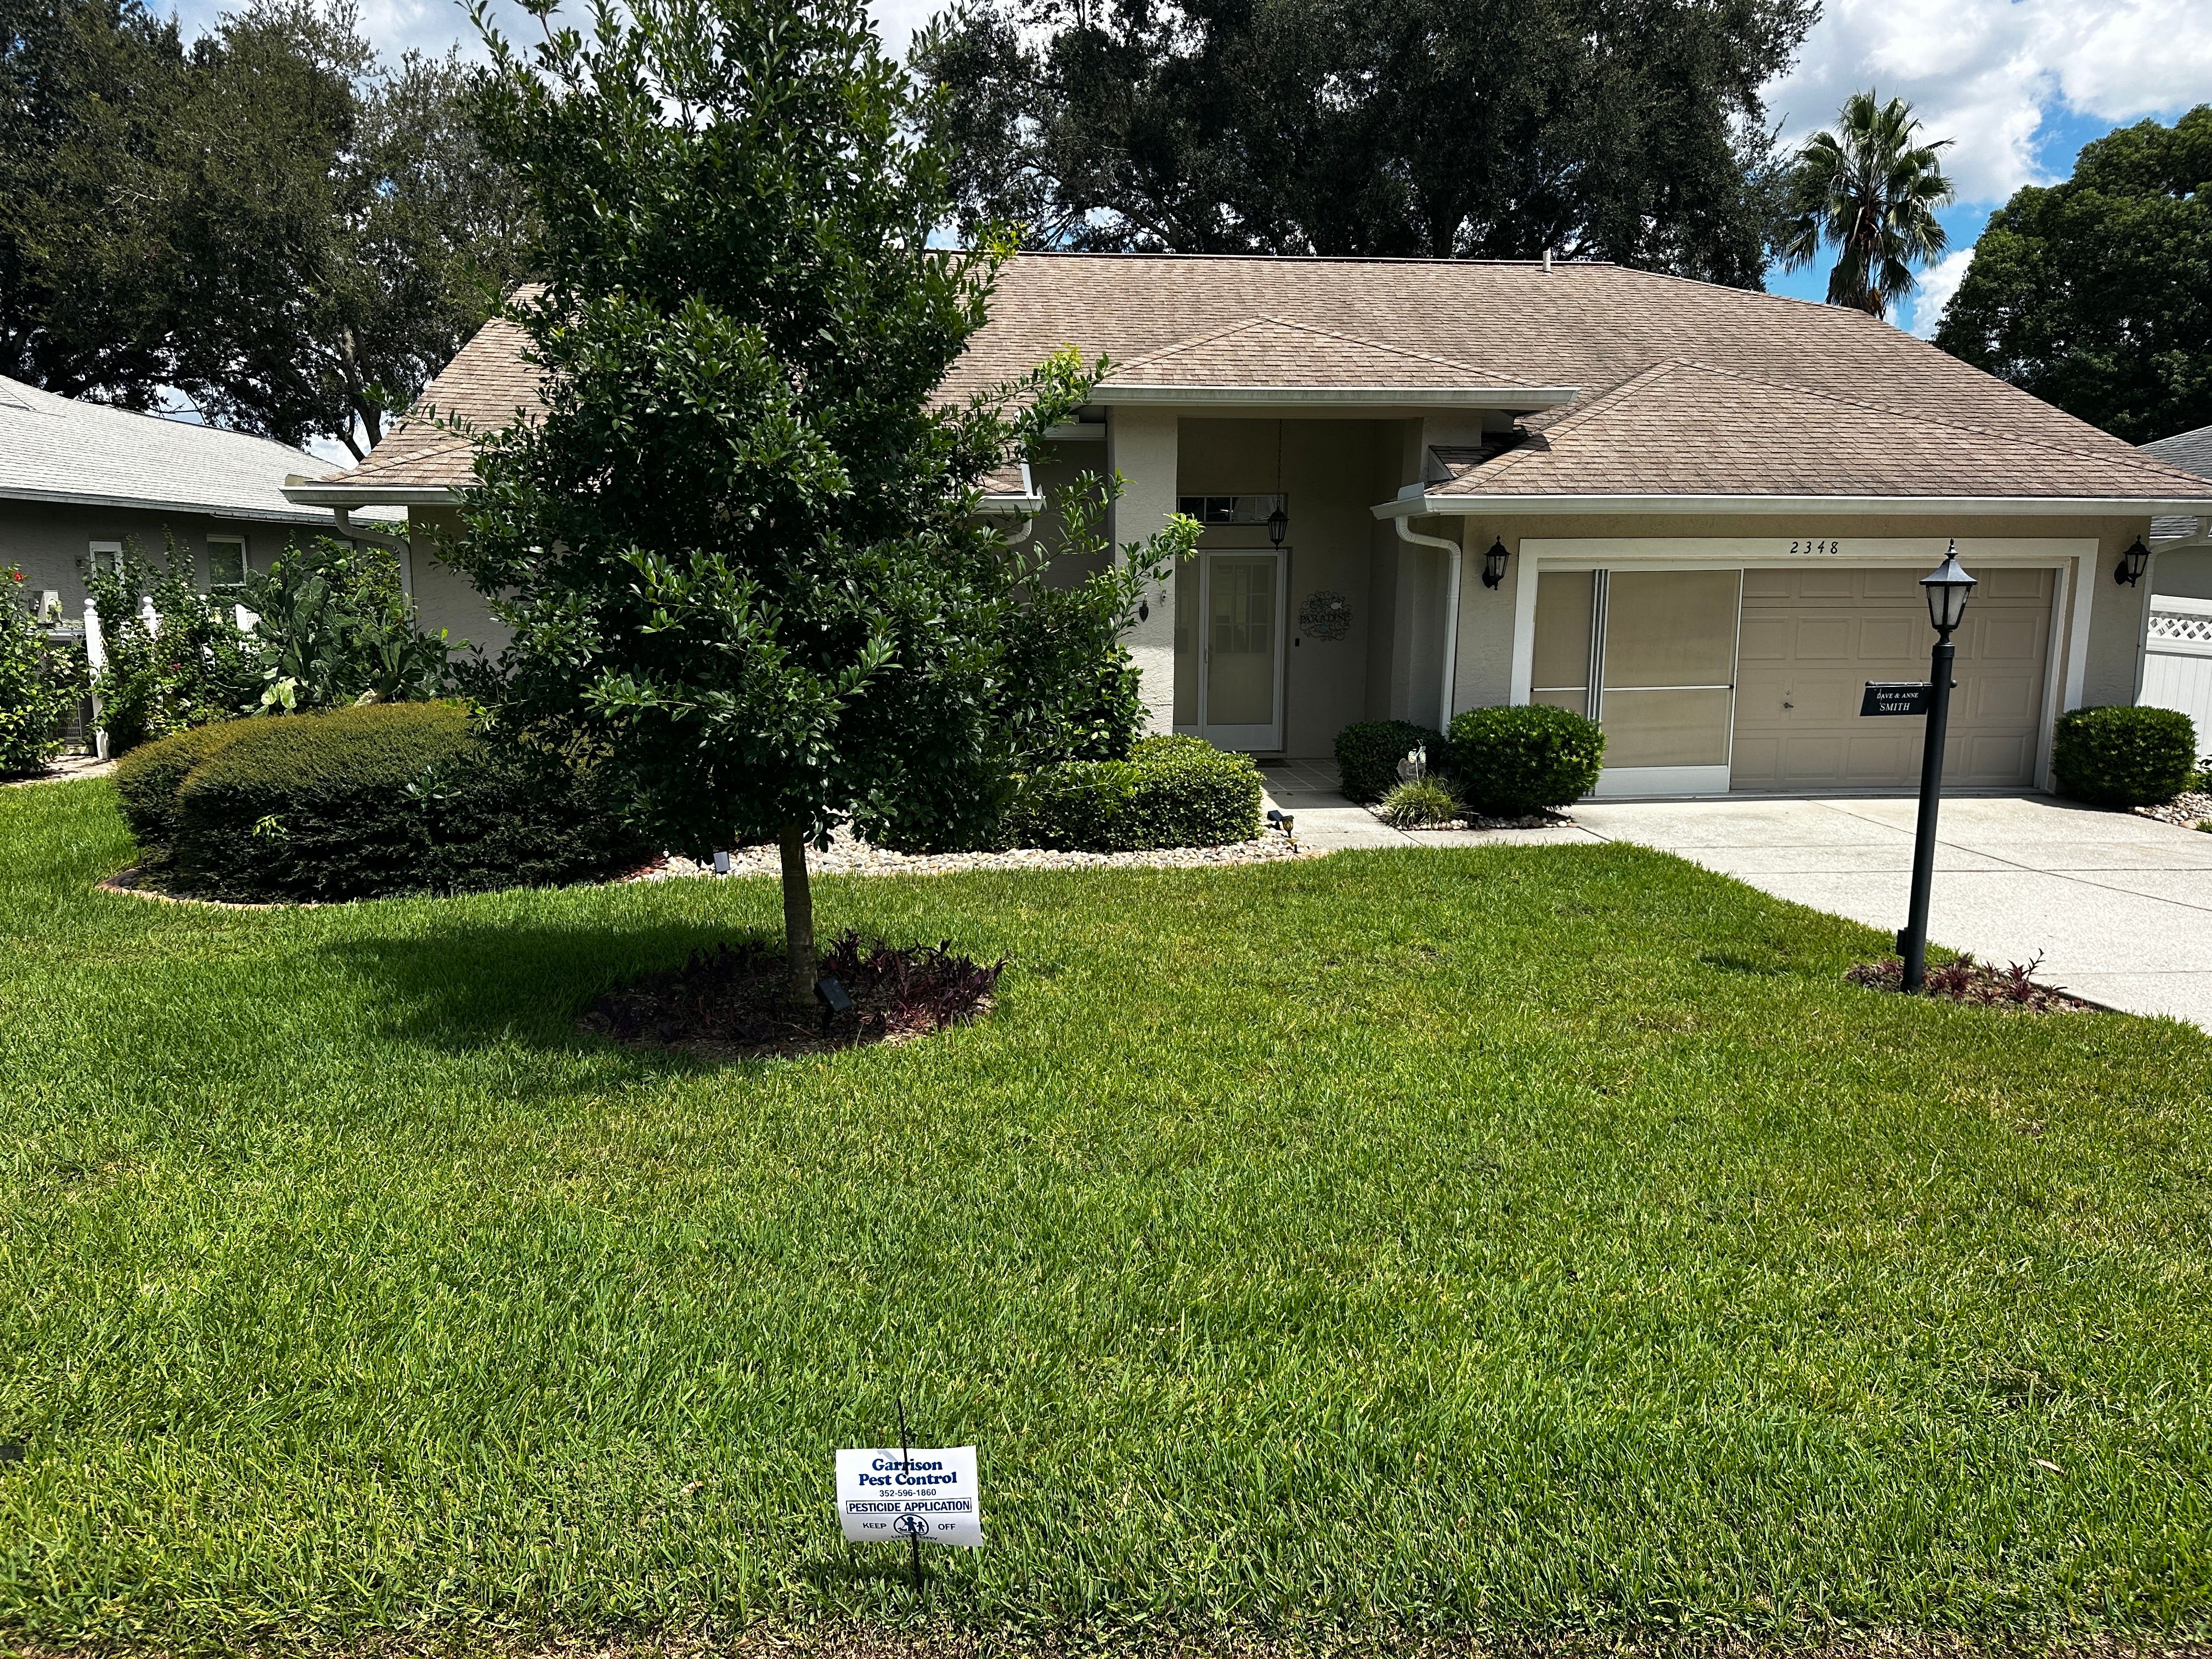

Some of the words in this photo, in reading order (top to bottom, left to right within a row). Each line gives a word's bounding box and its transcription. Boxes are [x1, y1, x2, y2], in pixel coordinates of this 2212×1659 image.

[1790, 541, 1838, 554] 2348
[1880, 703, 1910, 711] SMITH
[872, 1458, 943, 1471] Garrison
[859, 1474, 891, 1486] Pest
[895, 1471, 957, 1485] Control
[879, 1489, 936, 1497] 352-596-1860
[849, 1503, 901, 1512] PESTICIDE
[905, 1500, 970, 1511] APPLICATION
